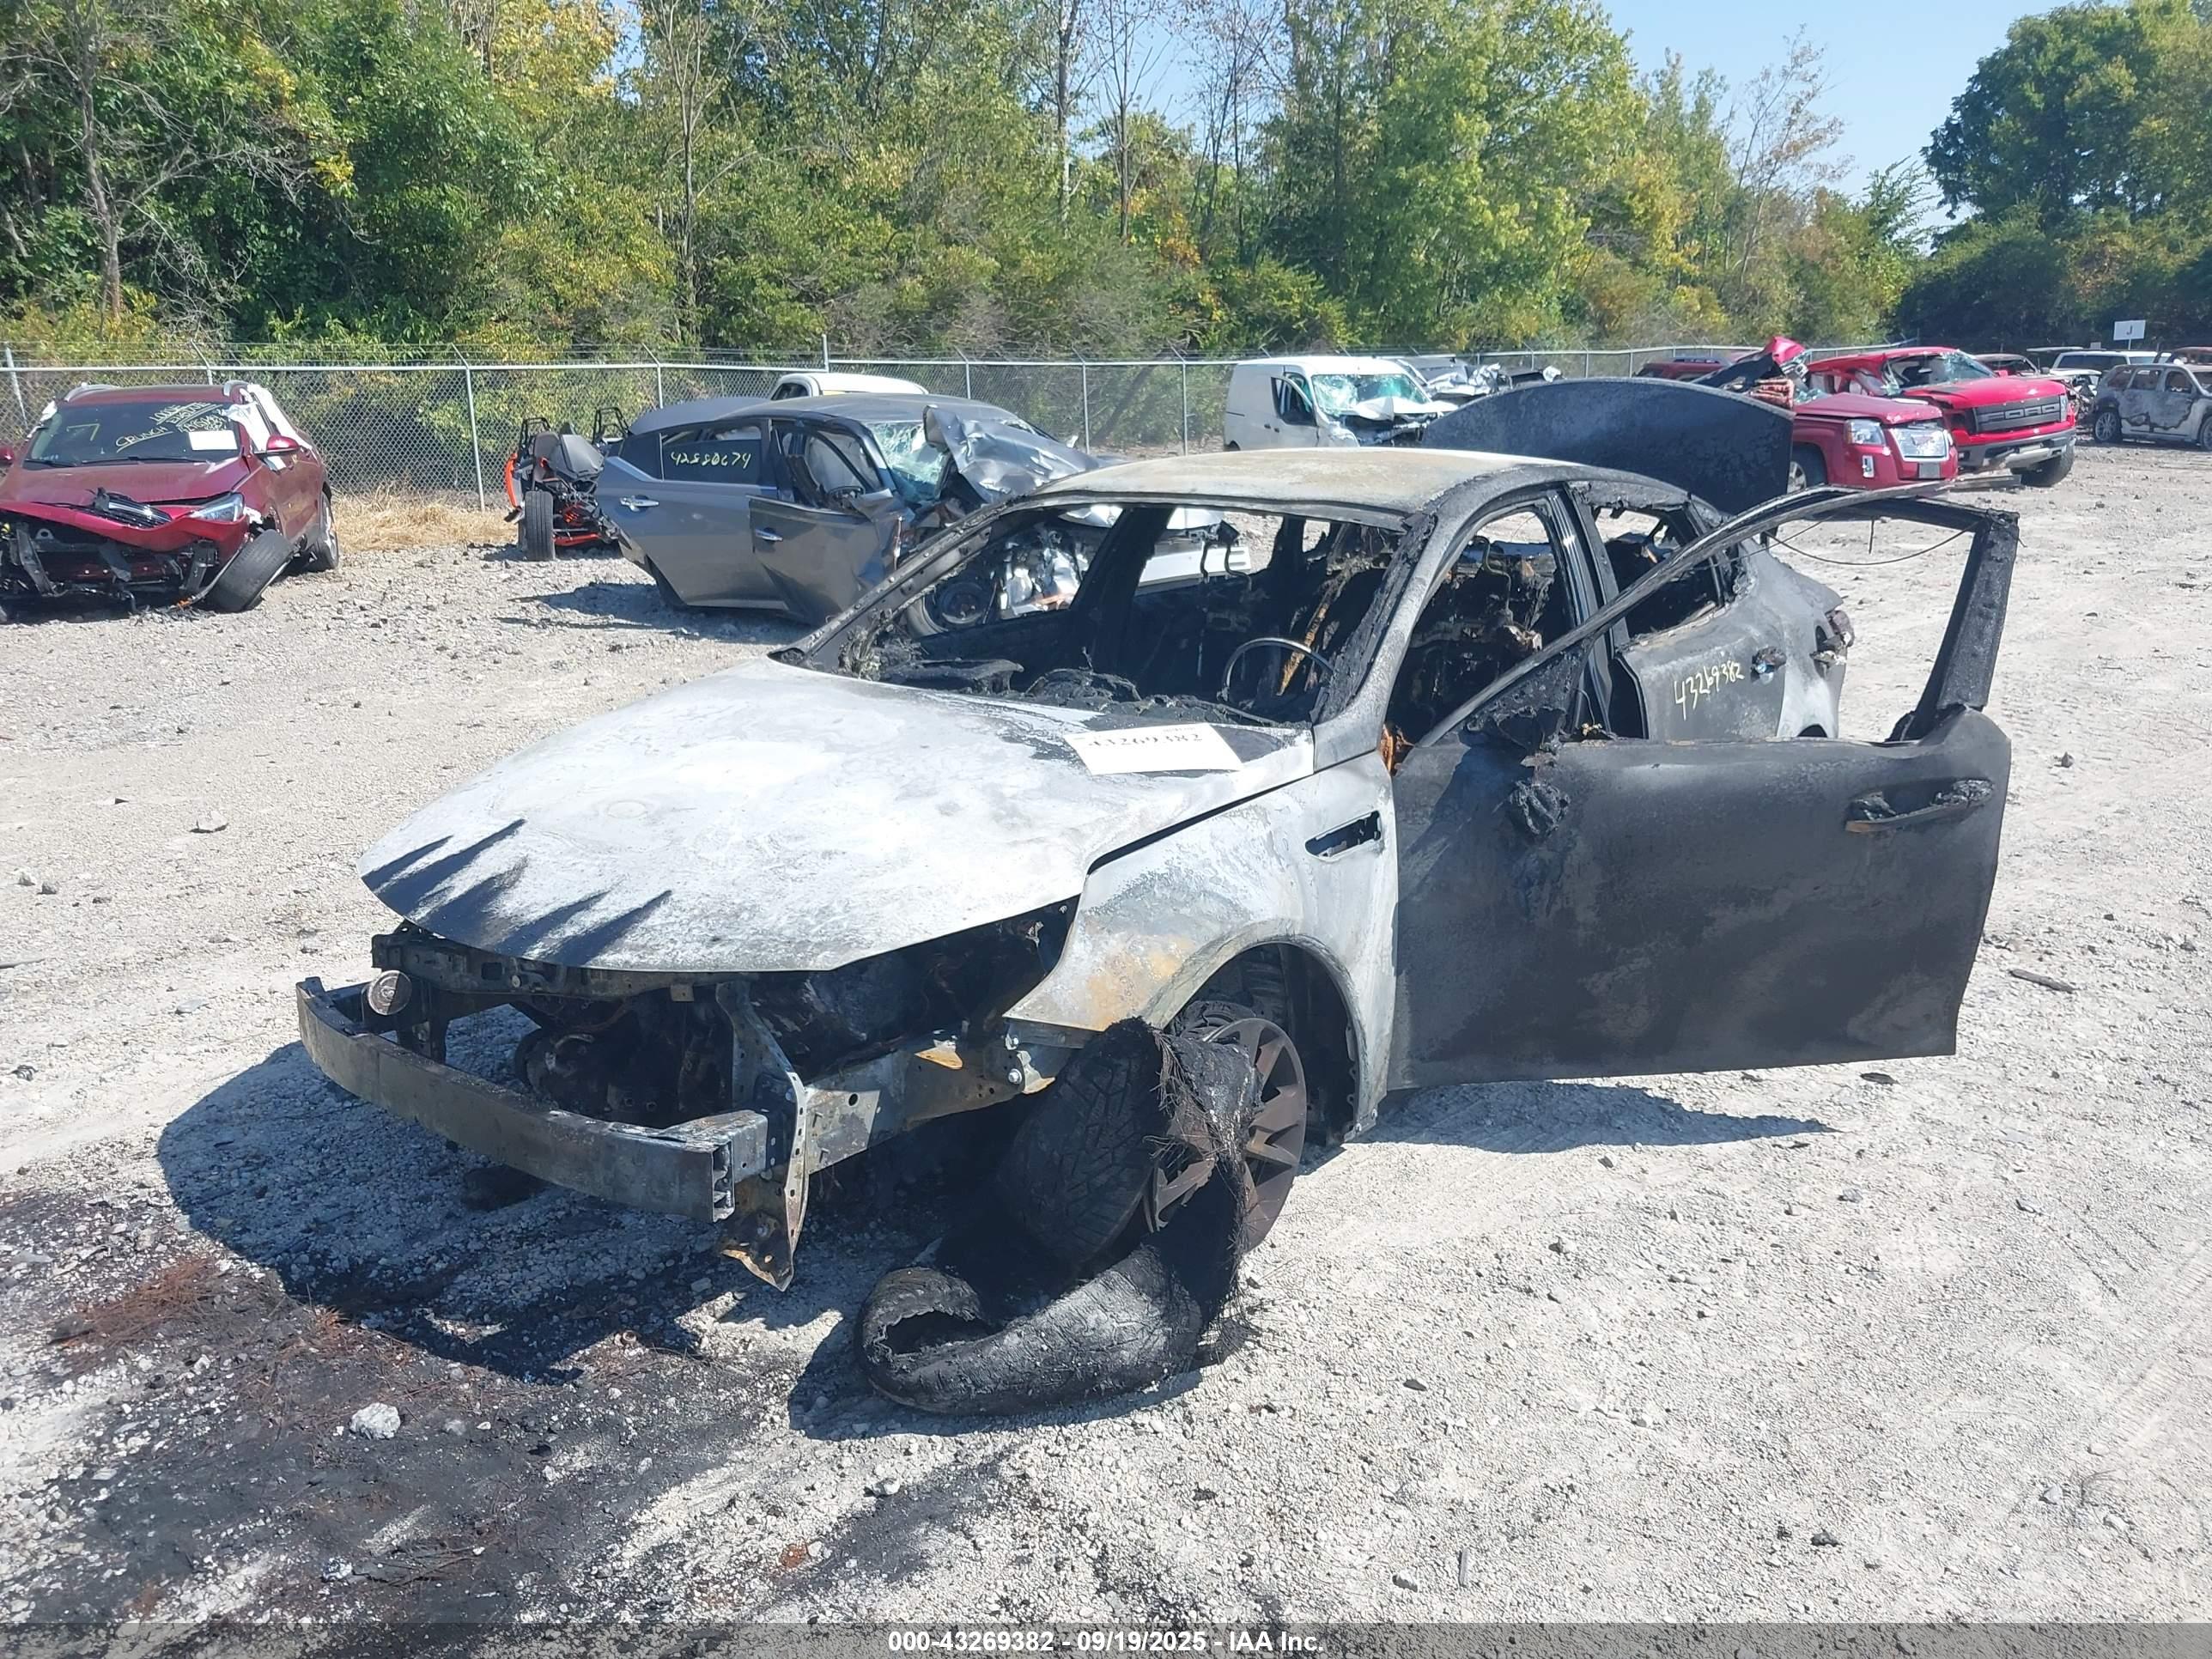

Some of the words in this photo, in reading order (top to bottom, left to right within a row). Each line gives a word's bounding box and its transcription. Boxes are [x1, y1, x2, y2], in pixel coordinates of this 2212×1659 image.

[2126, 325, 2133, 335] J
[1978, 403, 2060, 423] FORD
[1674, 660, 1745, 721] 43269382
